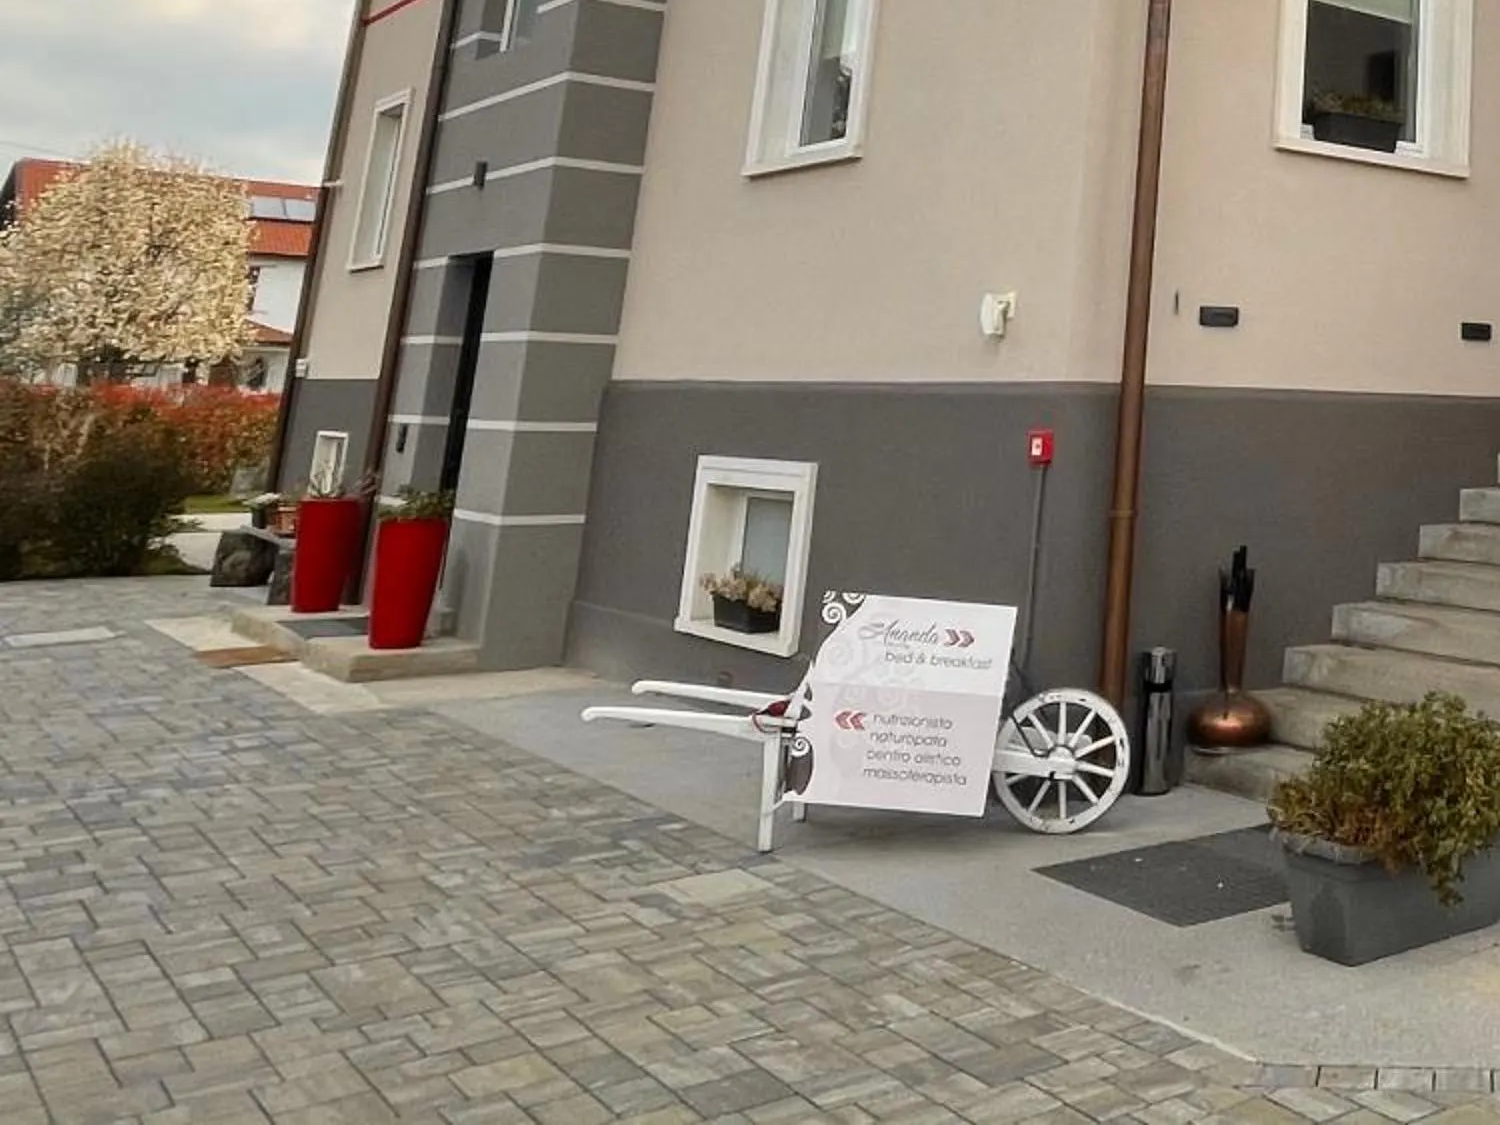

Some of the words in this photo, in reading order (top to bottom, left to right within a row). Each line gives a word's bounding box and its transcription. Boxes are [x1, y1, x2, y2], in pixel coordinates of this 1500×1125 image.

[885, 650, 913, 664] bed
[915, 652, 926, 665] &
[930, 653, 993, 671] breakfast
[873, 713, 953, 730] nutrizionista
[869, 731, 948, 748] naturopata
[866, 749, 911, 763] centro
[863, 767, 967, 786] massoterapista
